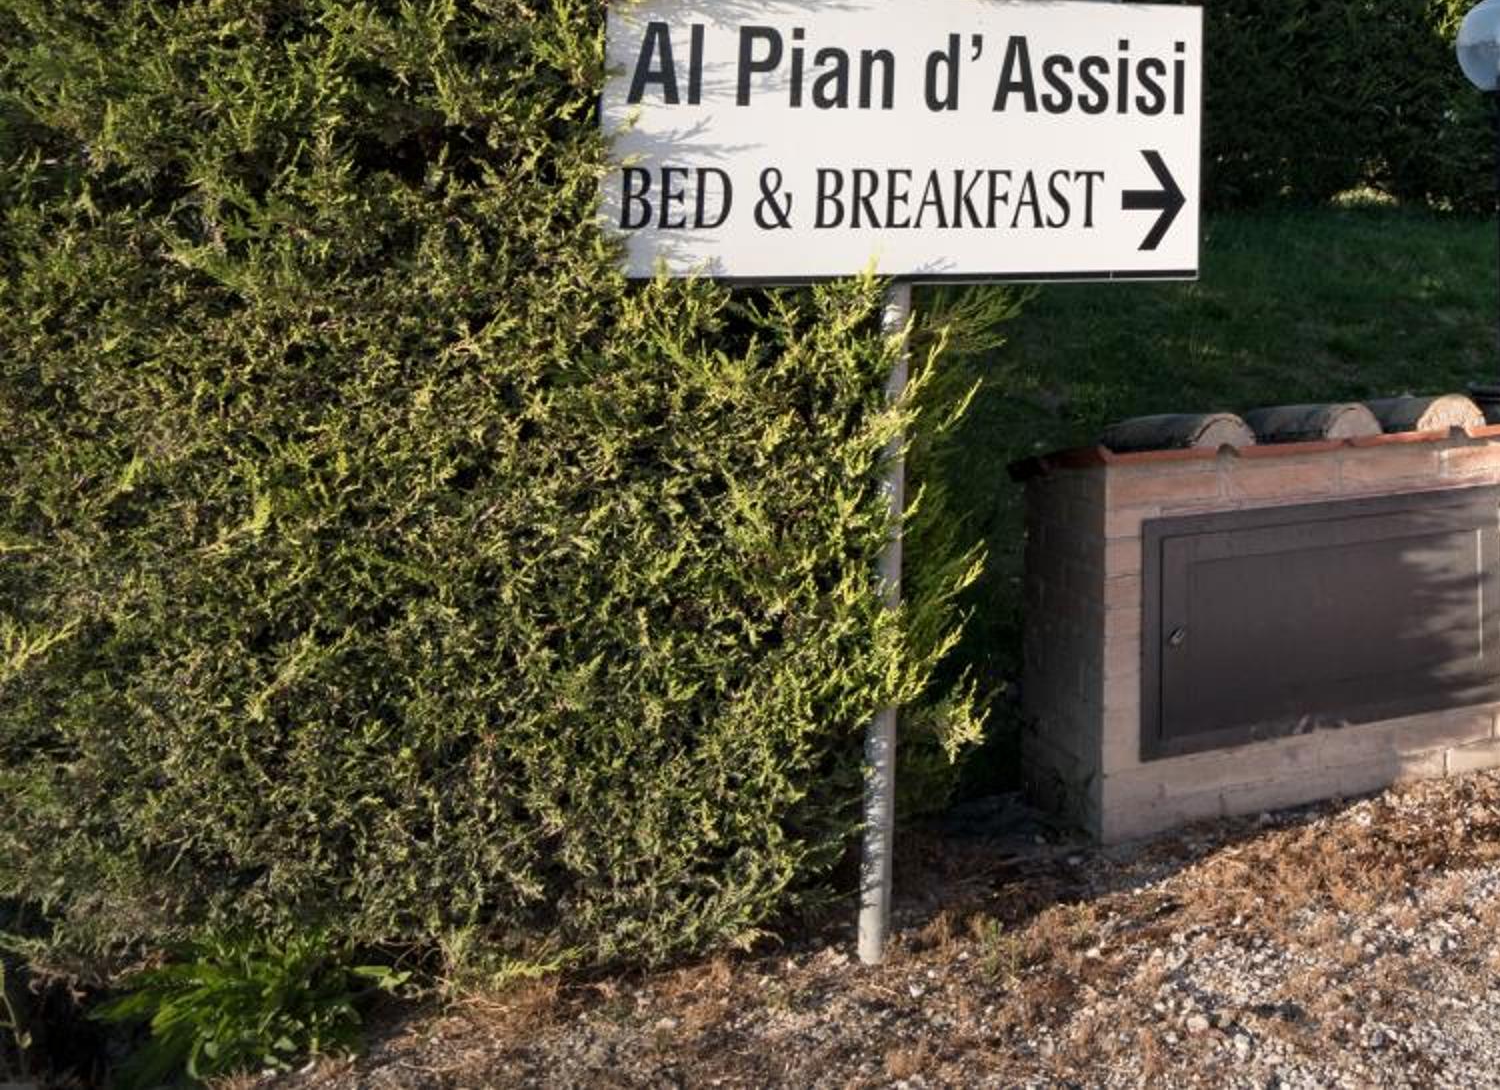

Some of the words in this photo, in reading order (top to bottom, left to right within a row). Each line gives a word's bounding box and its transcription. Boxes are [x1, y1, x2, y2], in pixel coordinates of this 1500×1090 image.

[626, 21, 705, 106] Al
[735, 25, 896, 111] Pian
[618, 166, 733, 231] BED
[753, 166, 793, 231] &
[813, 168, 1105, 230] BREAKFAST
